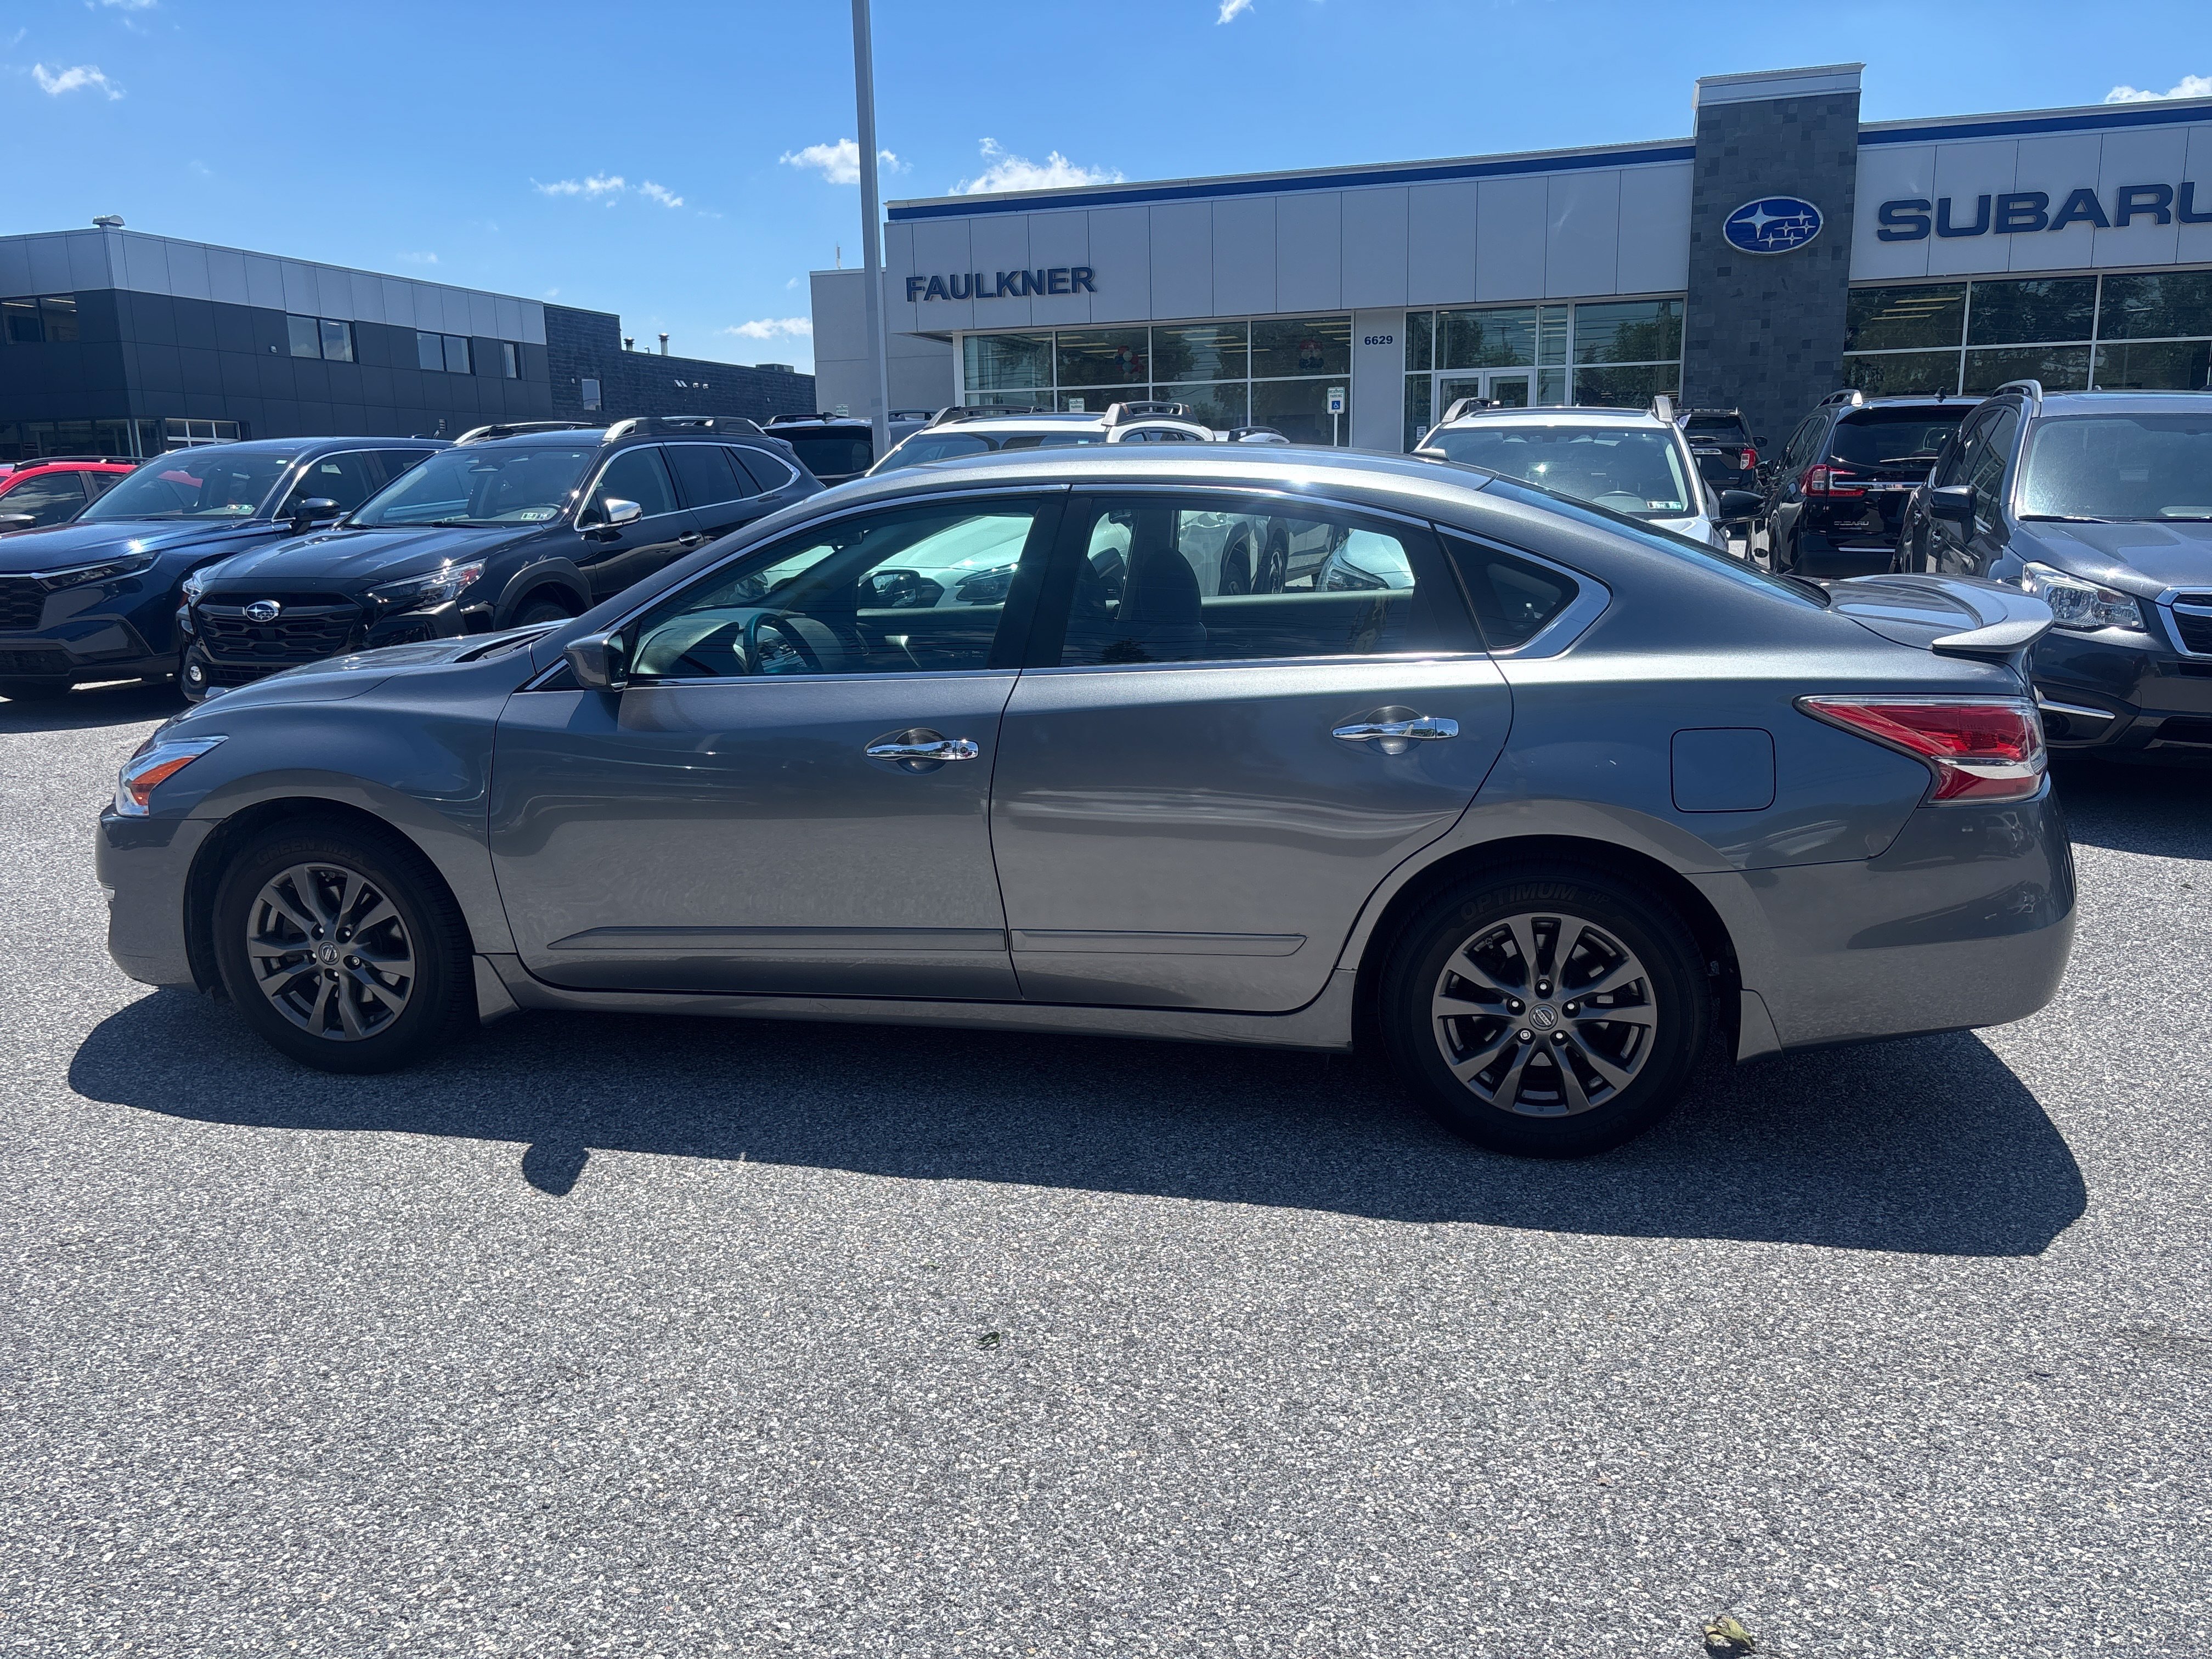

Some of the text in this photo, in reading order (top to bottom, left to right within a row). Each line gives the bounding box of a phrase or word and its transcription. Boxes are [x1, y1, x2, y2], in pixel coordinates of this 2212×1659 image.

[905, 267, 1096, 302] FAULKNER
[1364, 335, 1393, 345] 6629
[256, 837, 315, 866] GREEN
[1460, 882, 1611, 922] OPTIMUM HP
[1536, 1009, 1551, 1025] NISSAN
